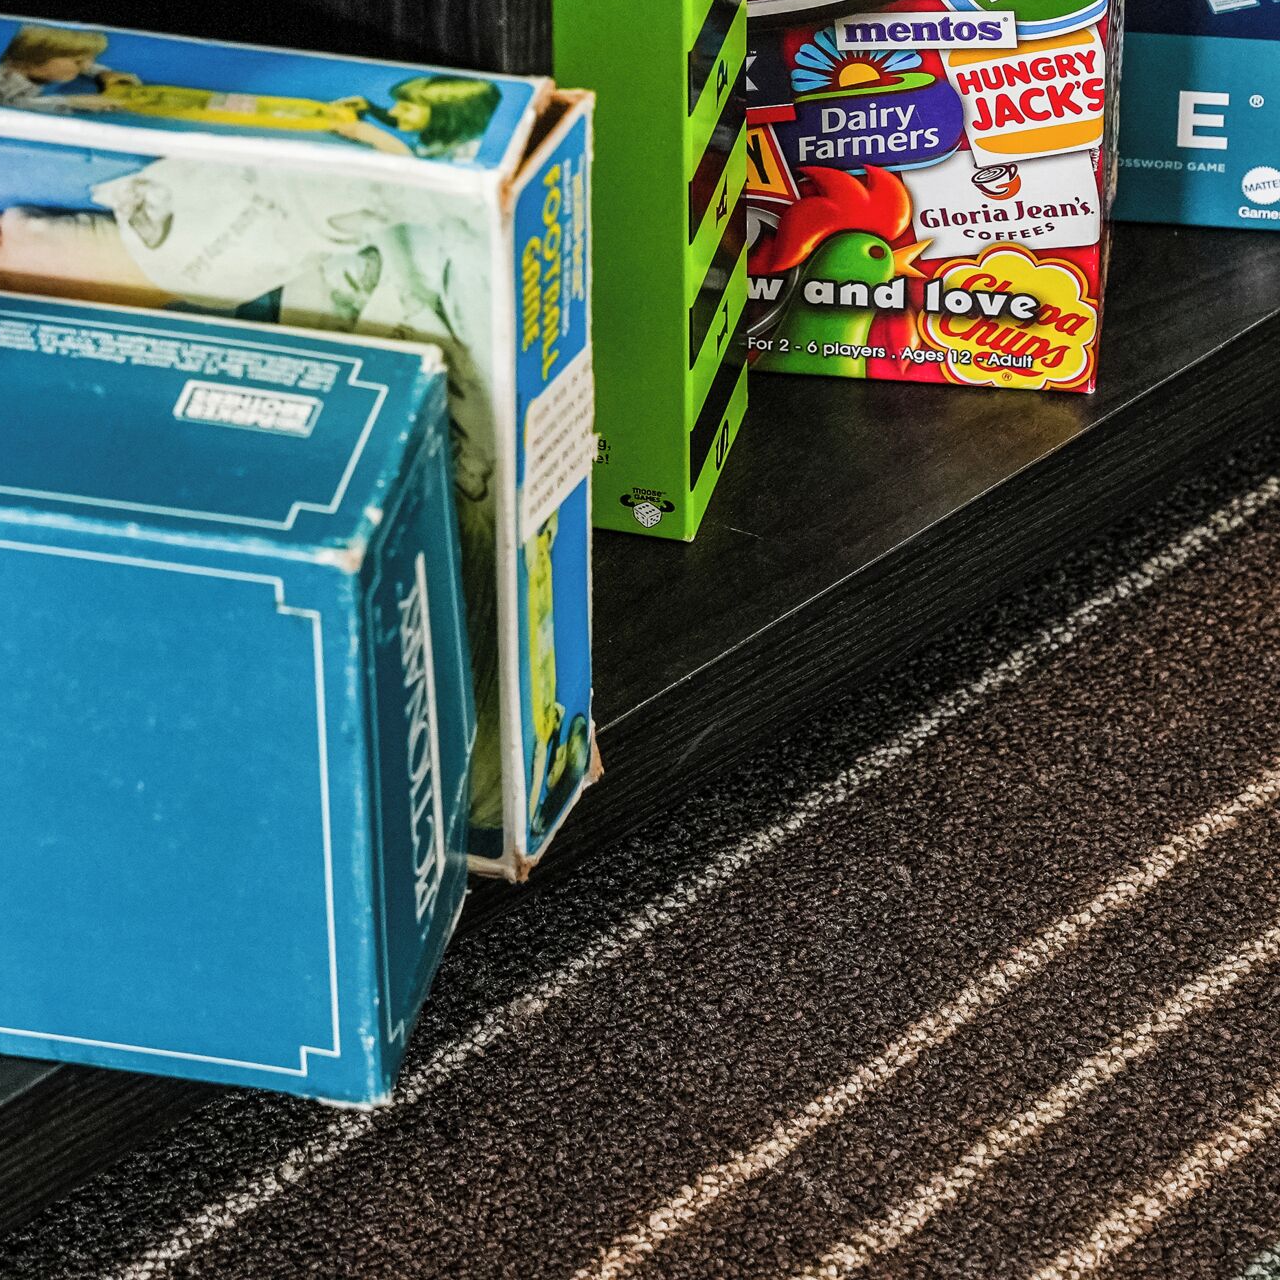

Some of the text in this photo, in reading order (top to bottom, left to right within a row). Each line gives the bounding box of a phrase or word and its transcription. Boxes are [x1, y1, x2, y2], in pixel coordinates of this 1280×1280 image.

[844, 16, 1004, 44] mentos
[955, 49, 1098, 97] HUNGRY
[820, 102, 917, 135] Dairy
[971, 76, 1106, 132] JACK'S
[1176, 90, 1231, 151] E
[798, 126, 941, 163] Farmers
[1186, 160, 1226, 174] GAME
[919, 204, 1010, 229] Gloria
[962, 222, 1056, 241] COFFEES
[804, 276, 905, 310] and
[926, 281, 1041, 320] love
[747, 335, 1034, 369] For 2 6 players Ages 12 Adult
[634, 493, 661, 503] GAMES
